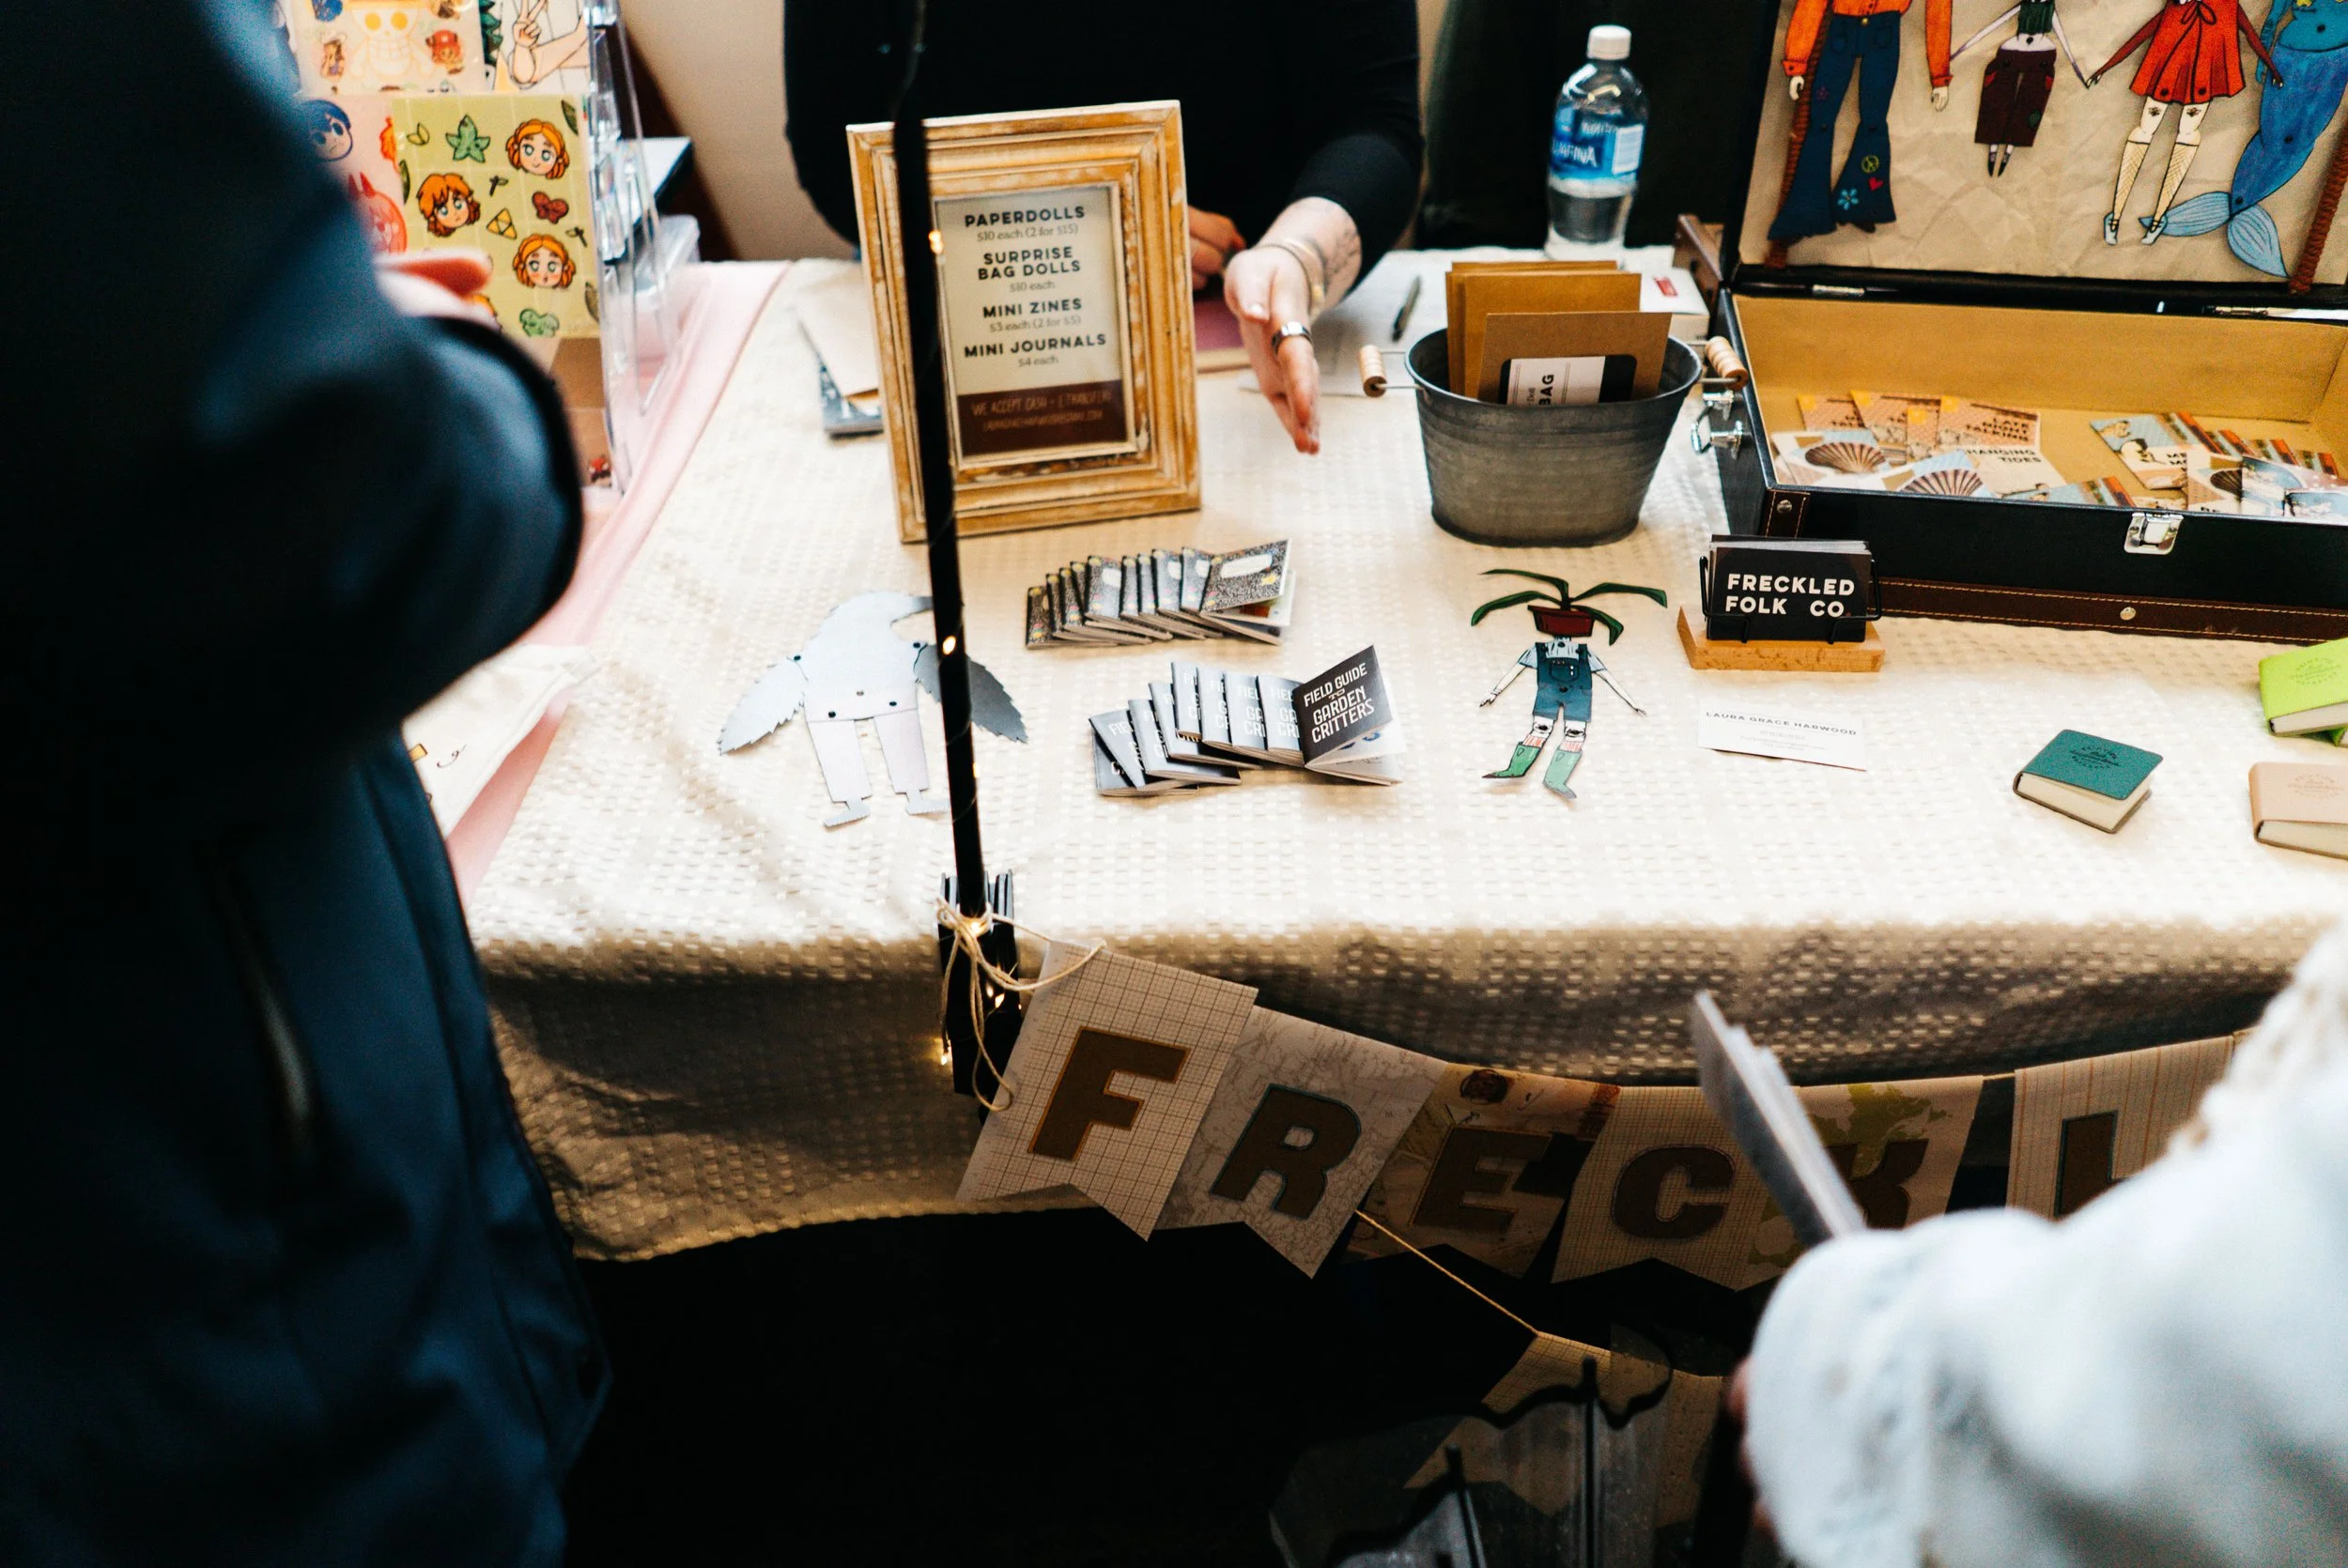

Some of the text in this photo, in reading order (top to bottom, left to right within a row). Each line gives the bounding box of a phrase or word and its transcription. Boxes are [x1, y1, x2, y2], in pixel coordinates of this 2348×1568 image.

[965, 206, 1085, 227] PAPERDOLLS
[977, 231, 995, 242] $10
[997, 228, 1023, 239] each
[1039, 225, 1054, 237] for
[983, 246, 1074, 265] SURPRISE
[978, 260, 1081, 280] BAG DOLLS
[1029, 280, 1056, 291] each
[983, 298, 1082, 318] MINI ZINES
[1005, 319, 1031, 331] each
[1046, 316, 1061, 328] for
[965, 333, 1107, 358] MINI JOURNALS
[1033, 355, 1058, 366] each
[1727, 574, 1855, 596] FRECKLED
[1725, 595, 1787, 615] FOLK
[1304, 662, 1367, 707] FIELD GUIDE
[1328, 688, 1346, 700] TO
[1313, 685, 1367, 726] GARDEN
[1311, 699, 1375, 744] CRITTERS
[1706, 712, 1745, 721] LAURA
[1750, 716, 1790, 726] GRACE
[1794, 722, 1857, 736] HARWOOD
